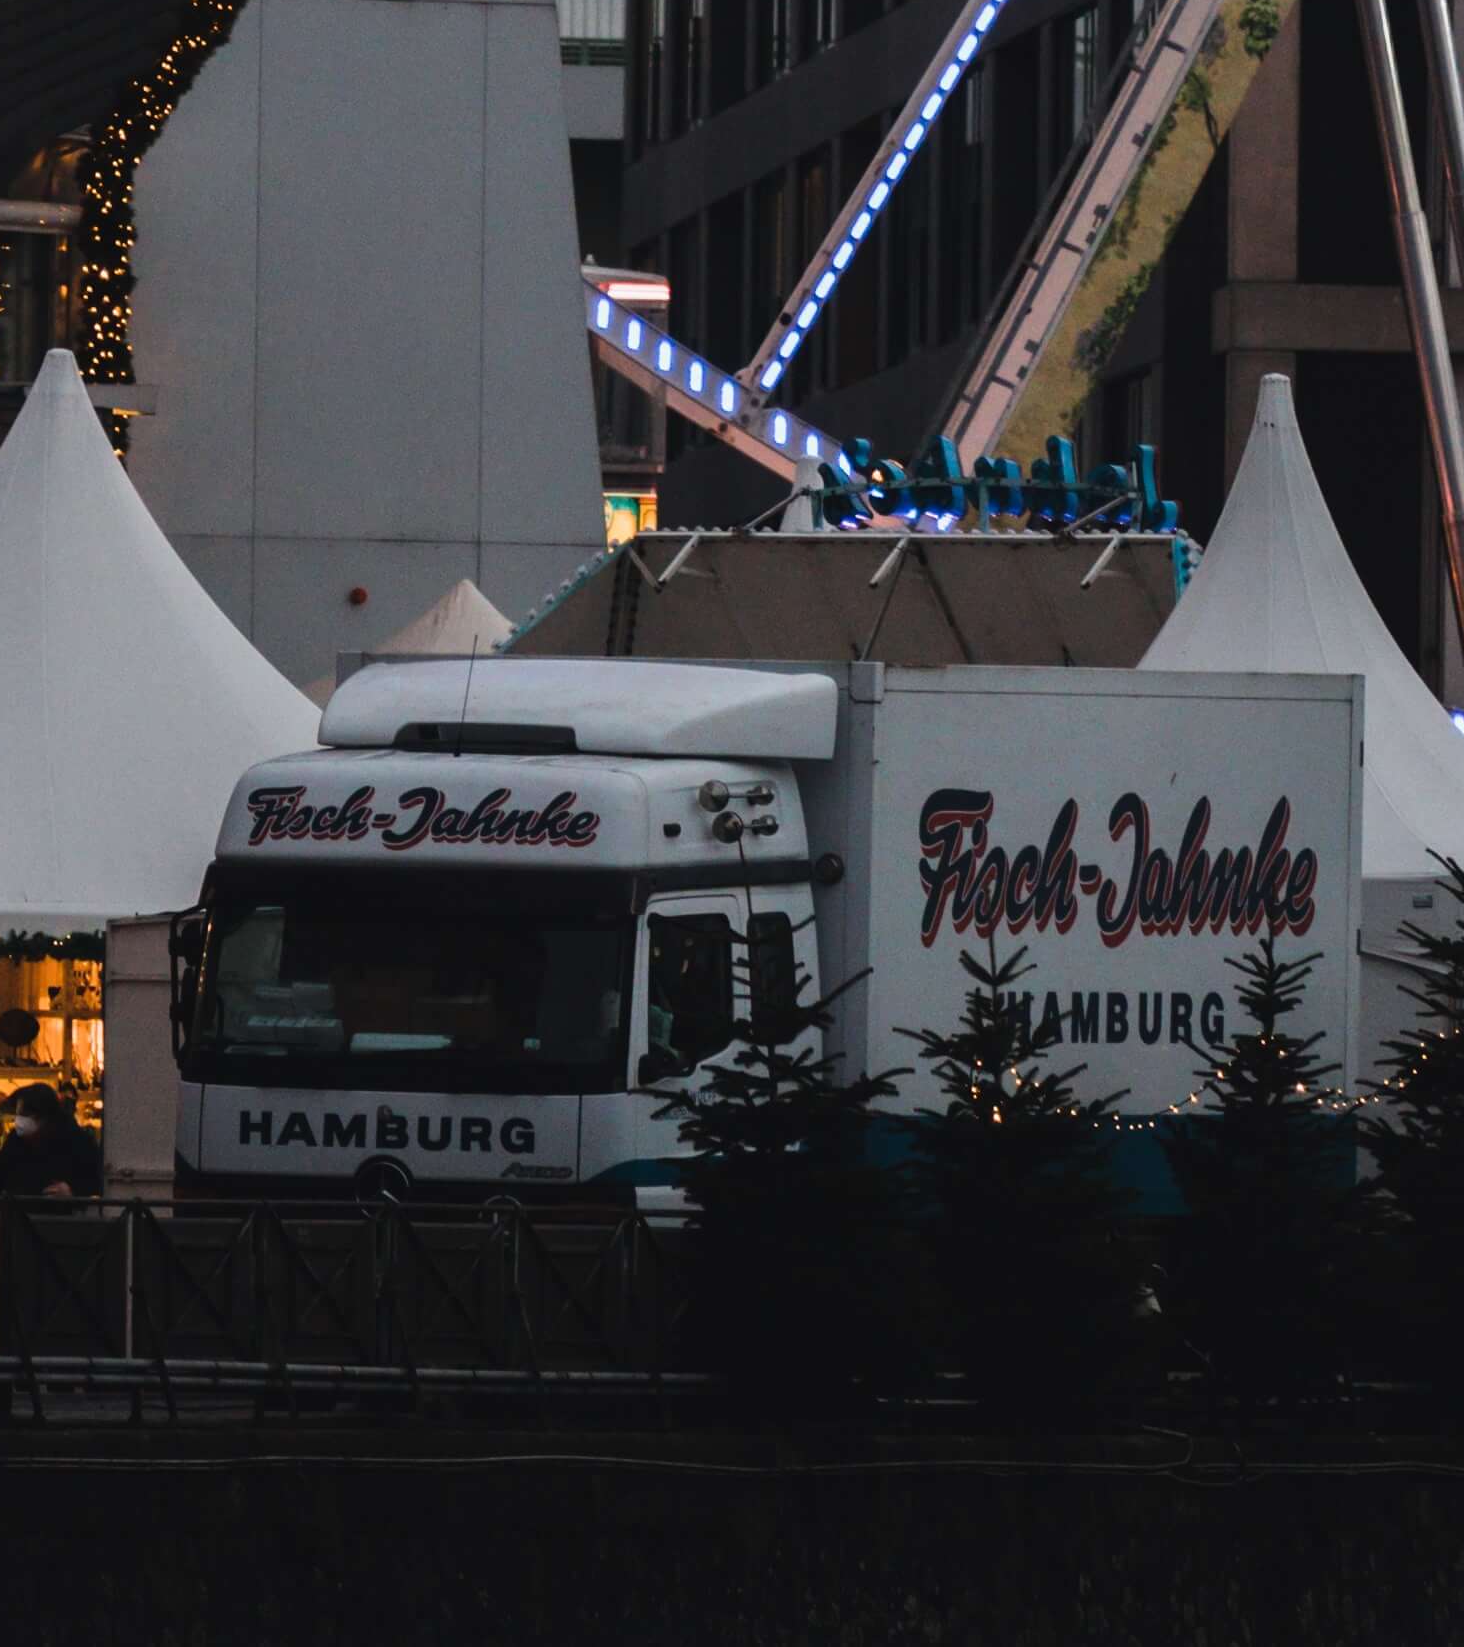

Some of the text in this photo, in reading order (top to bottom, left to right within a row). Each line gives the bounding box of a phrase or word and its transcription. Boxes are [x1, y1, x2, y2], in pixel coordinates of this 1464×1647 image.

[247, 785, 600, 850] Fisch-Jahnke
[918, 788, 1318, 948] Fisch-Jahnke
[1004, 991, 1225, 1044] HAMBURG
[239, 1109, 535, 1154] HAMBURG
